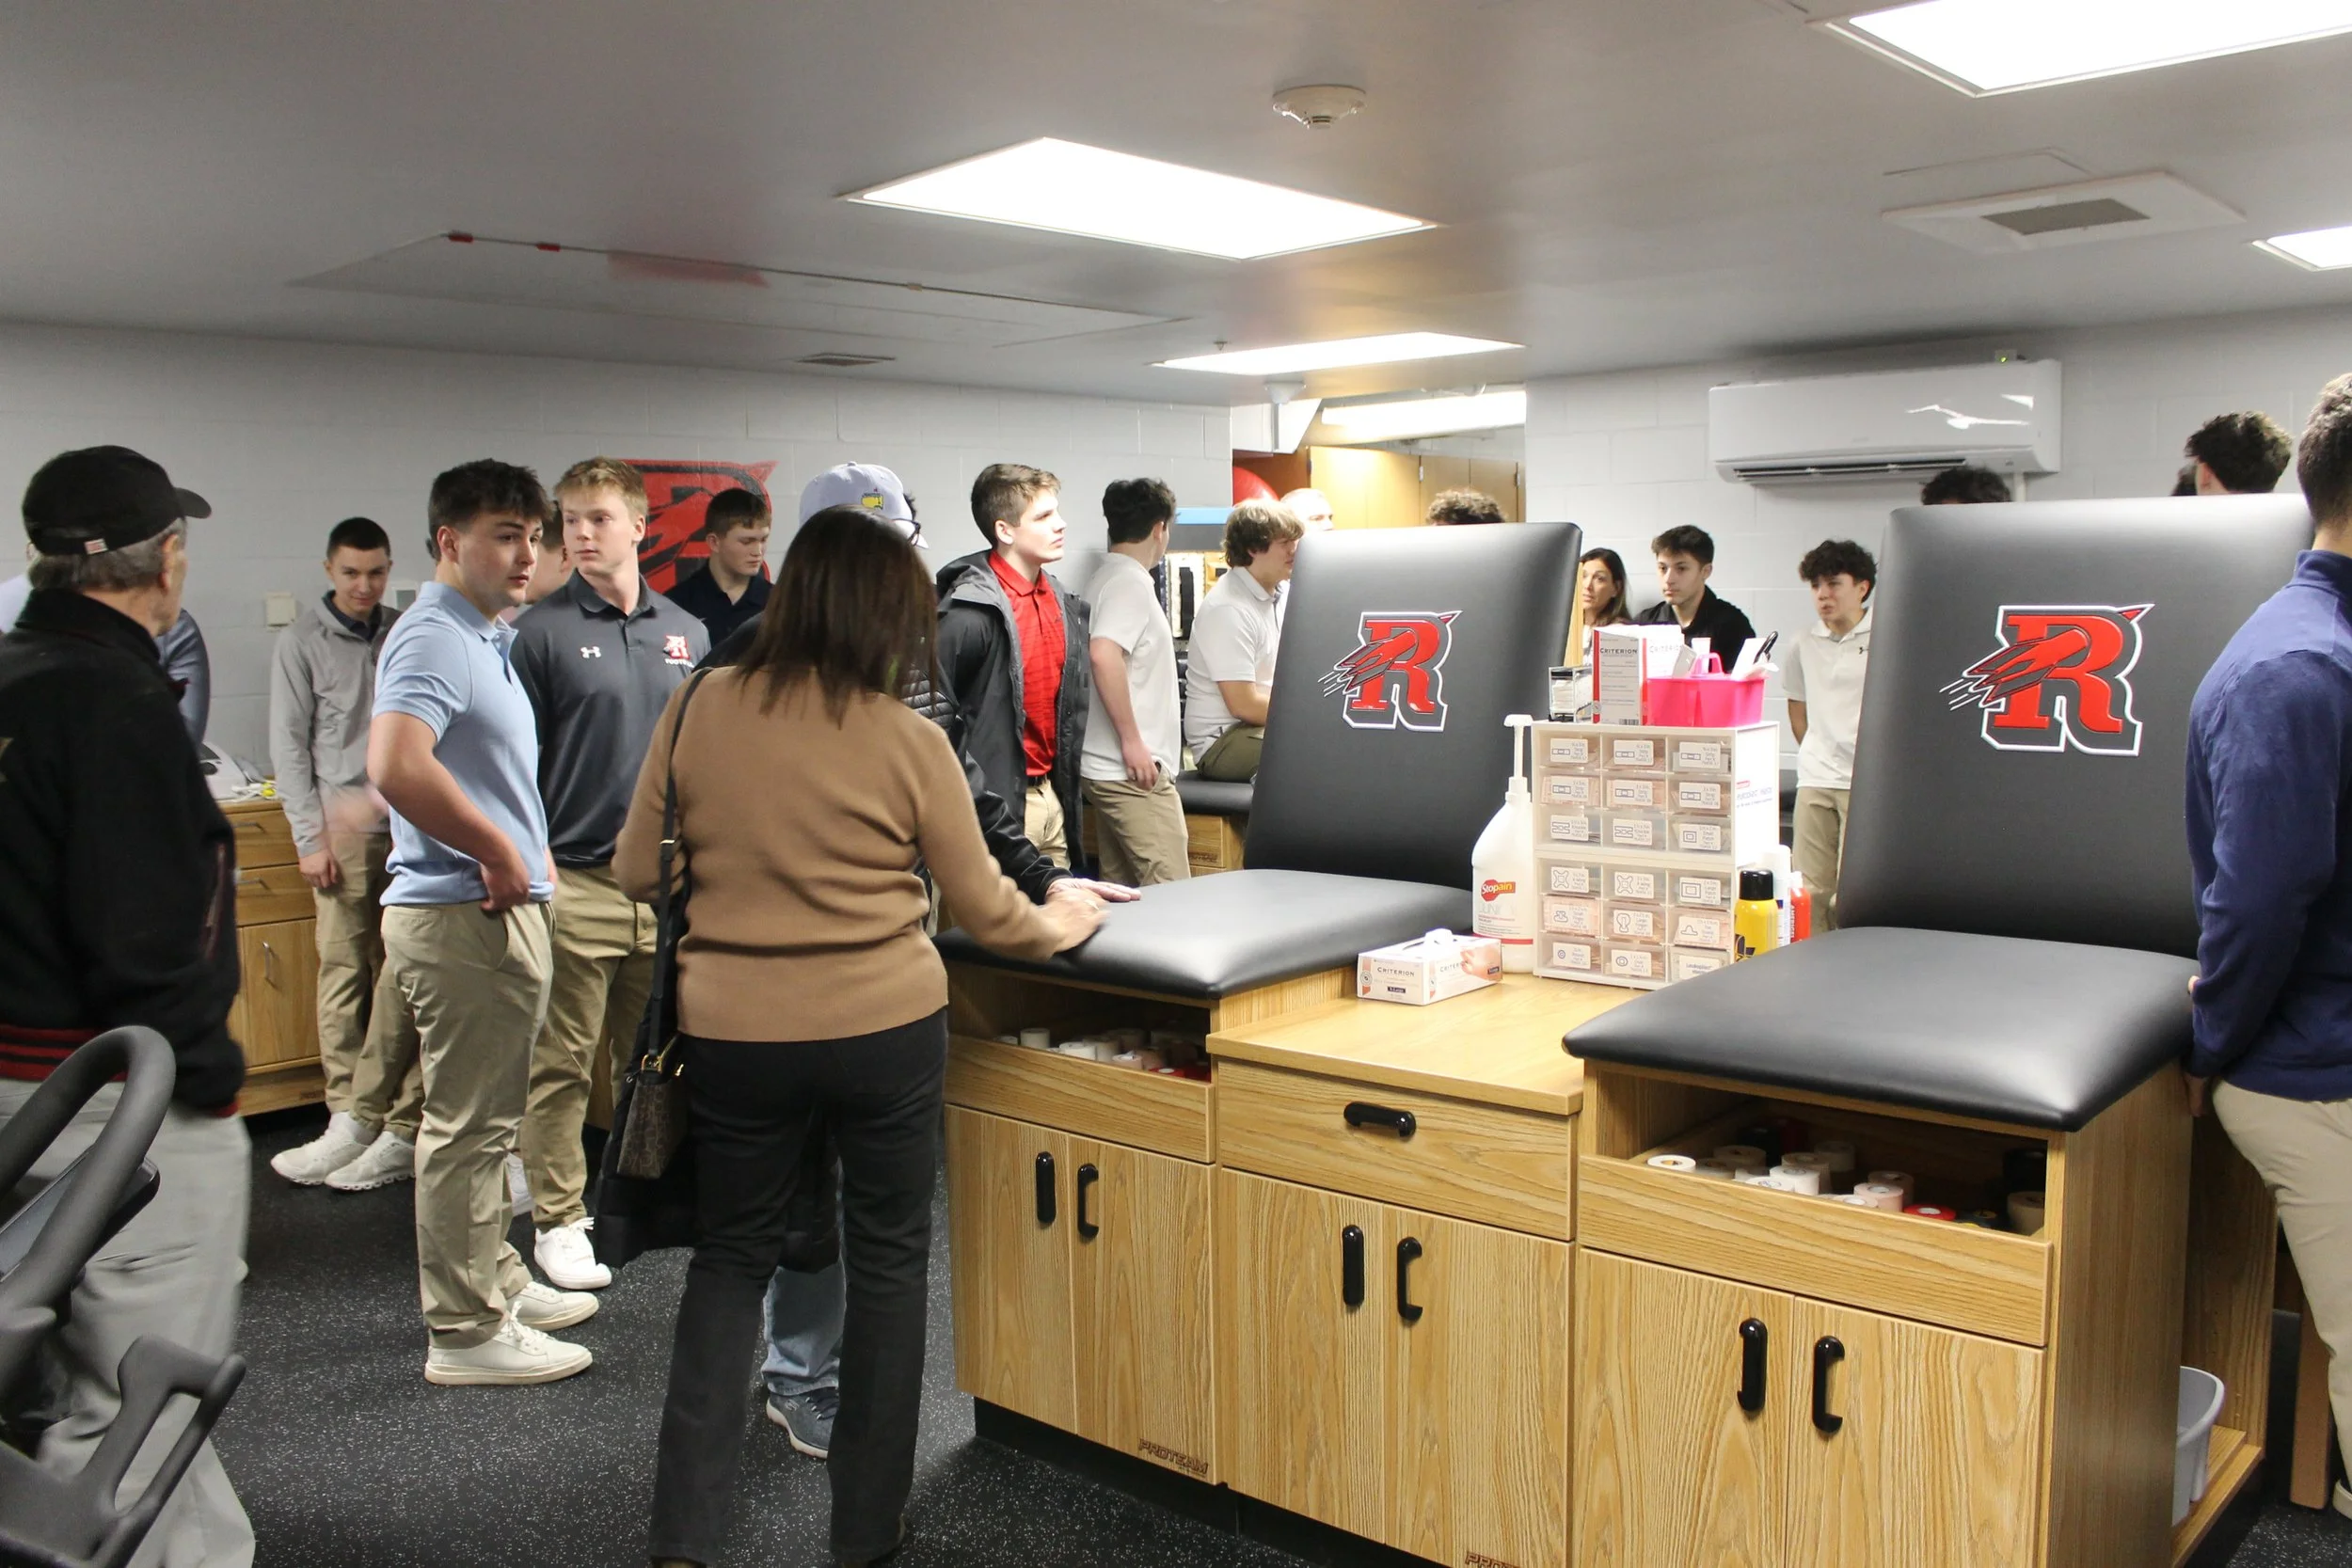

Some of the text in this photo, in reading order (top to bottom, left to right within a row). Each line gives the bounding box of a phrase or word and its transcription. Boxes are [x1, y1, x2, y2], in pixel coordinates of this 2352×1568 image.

[1599, 646, 1638, 655] CRITERION
[1649, 644, 1682, 654] CRITERIO
[1343, 610, 1448, 732] R
[1981, 604, 2143, 756] R
[1482, 882, 1513, 895] Stopain
[1376, 966, 1415, 977] CRITERION
[1137, 1437, 1209, 1474] PROTEAM
